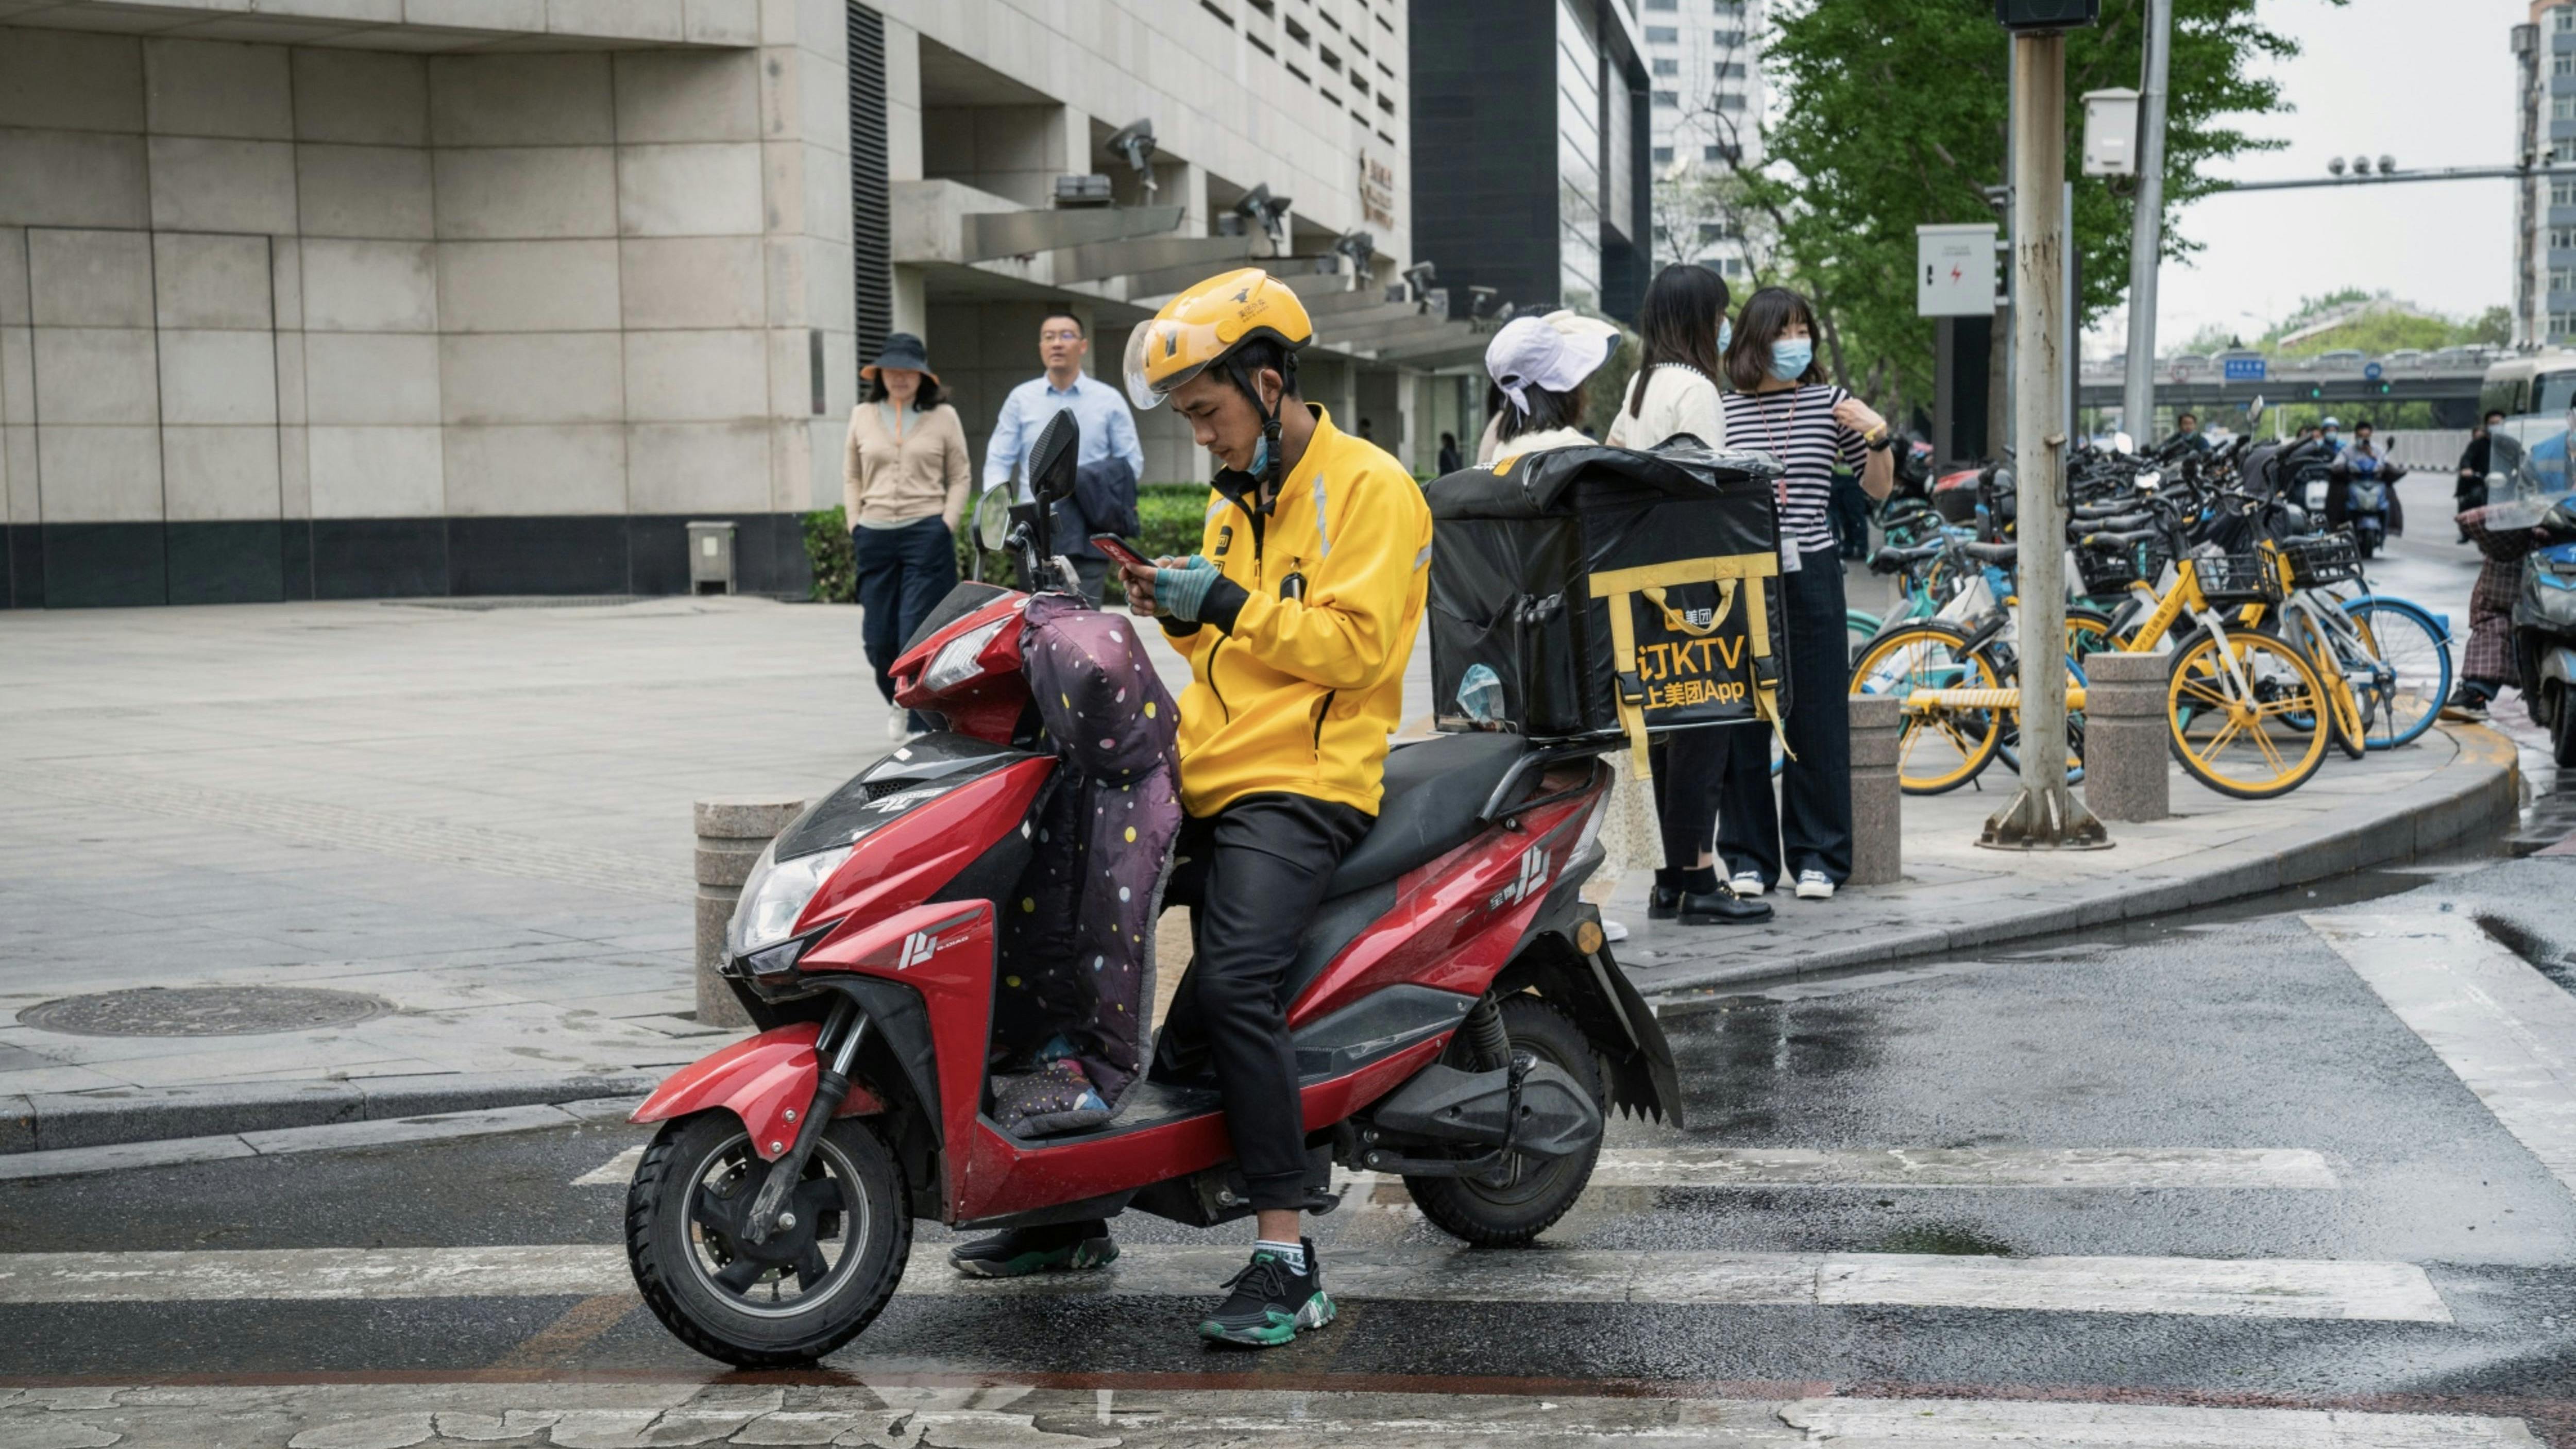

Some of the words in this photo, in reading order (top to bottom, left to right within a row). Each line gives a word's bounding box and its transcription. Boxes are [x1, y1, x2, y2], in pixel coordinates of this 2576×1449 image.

[1685, 608, 1712, 626] 美团
[1637, 635, 1745, 682] 订KTV
[1643, 679, 1745, 710] 上美团App
